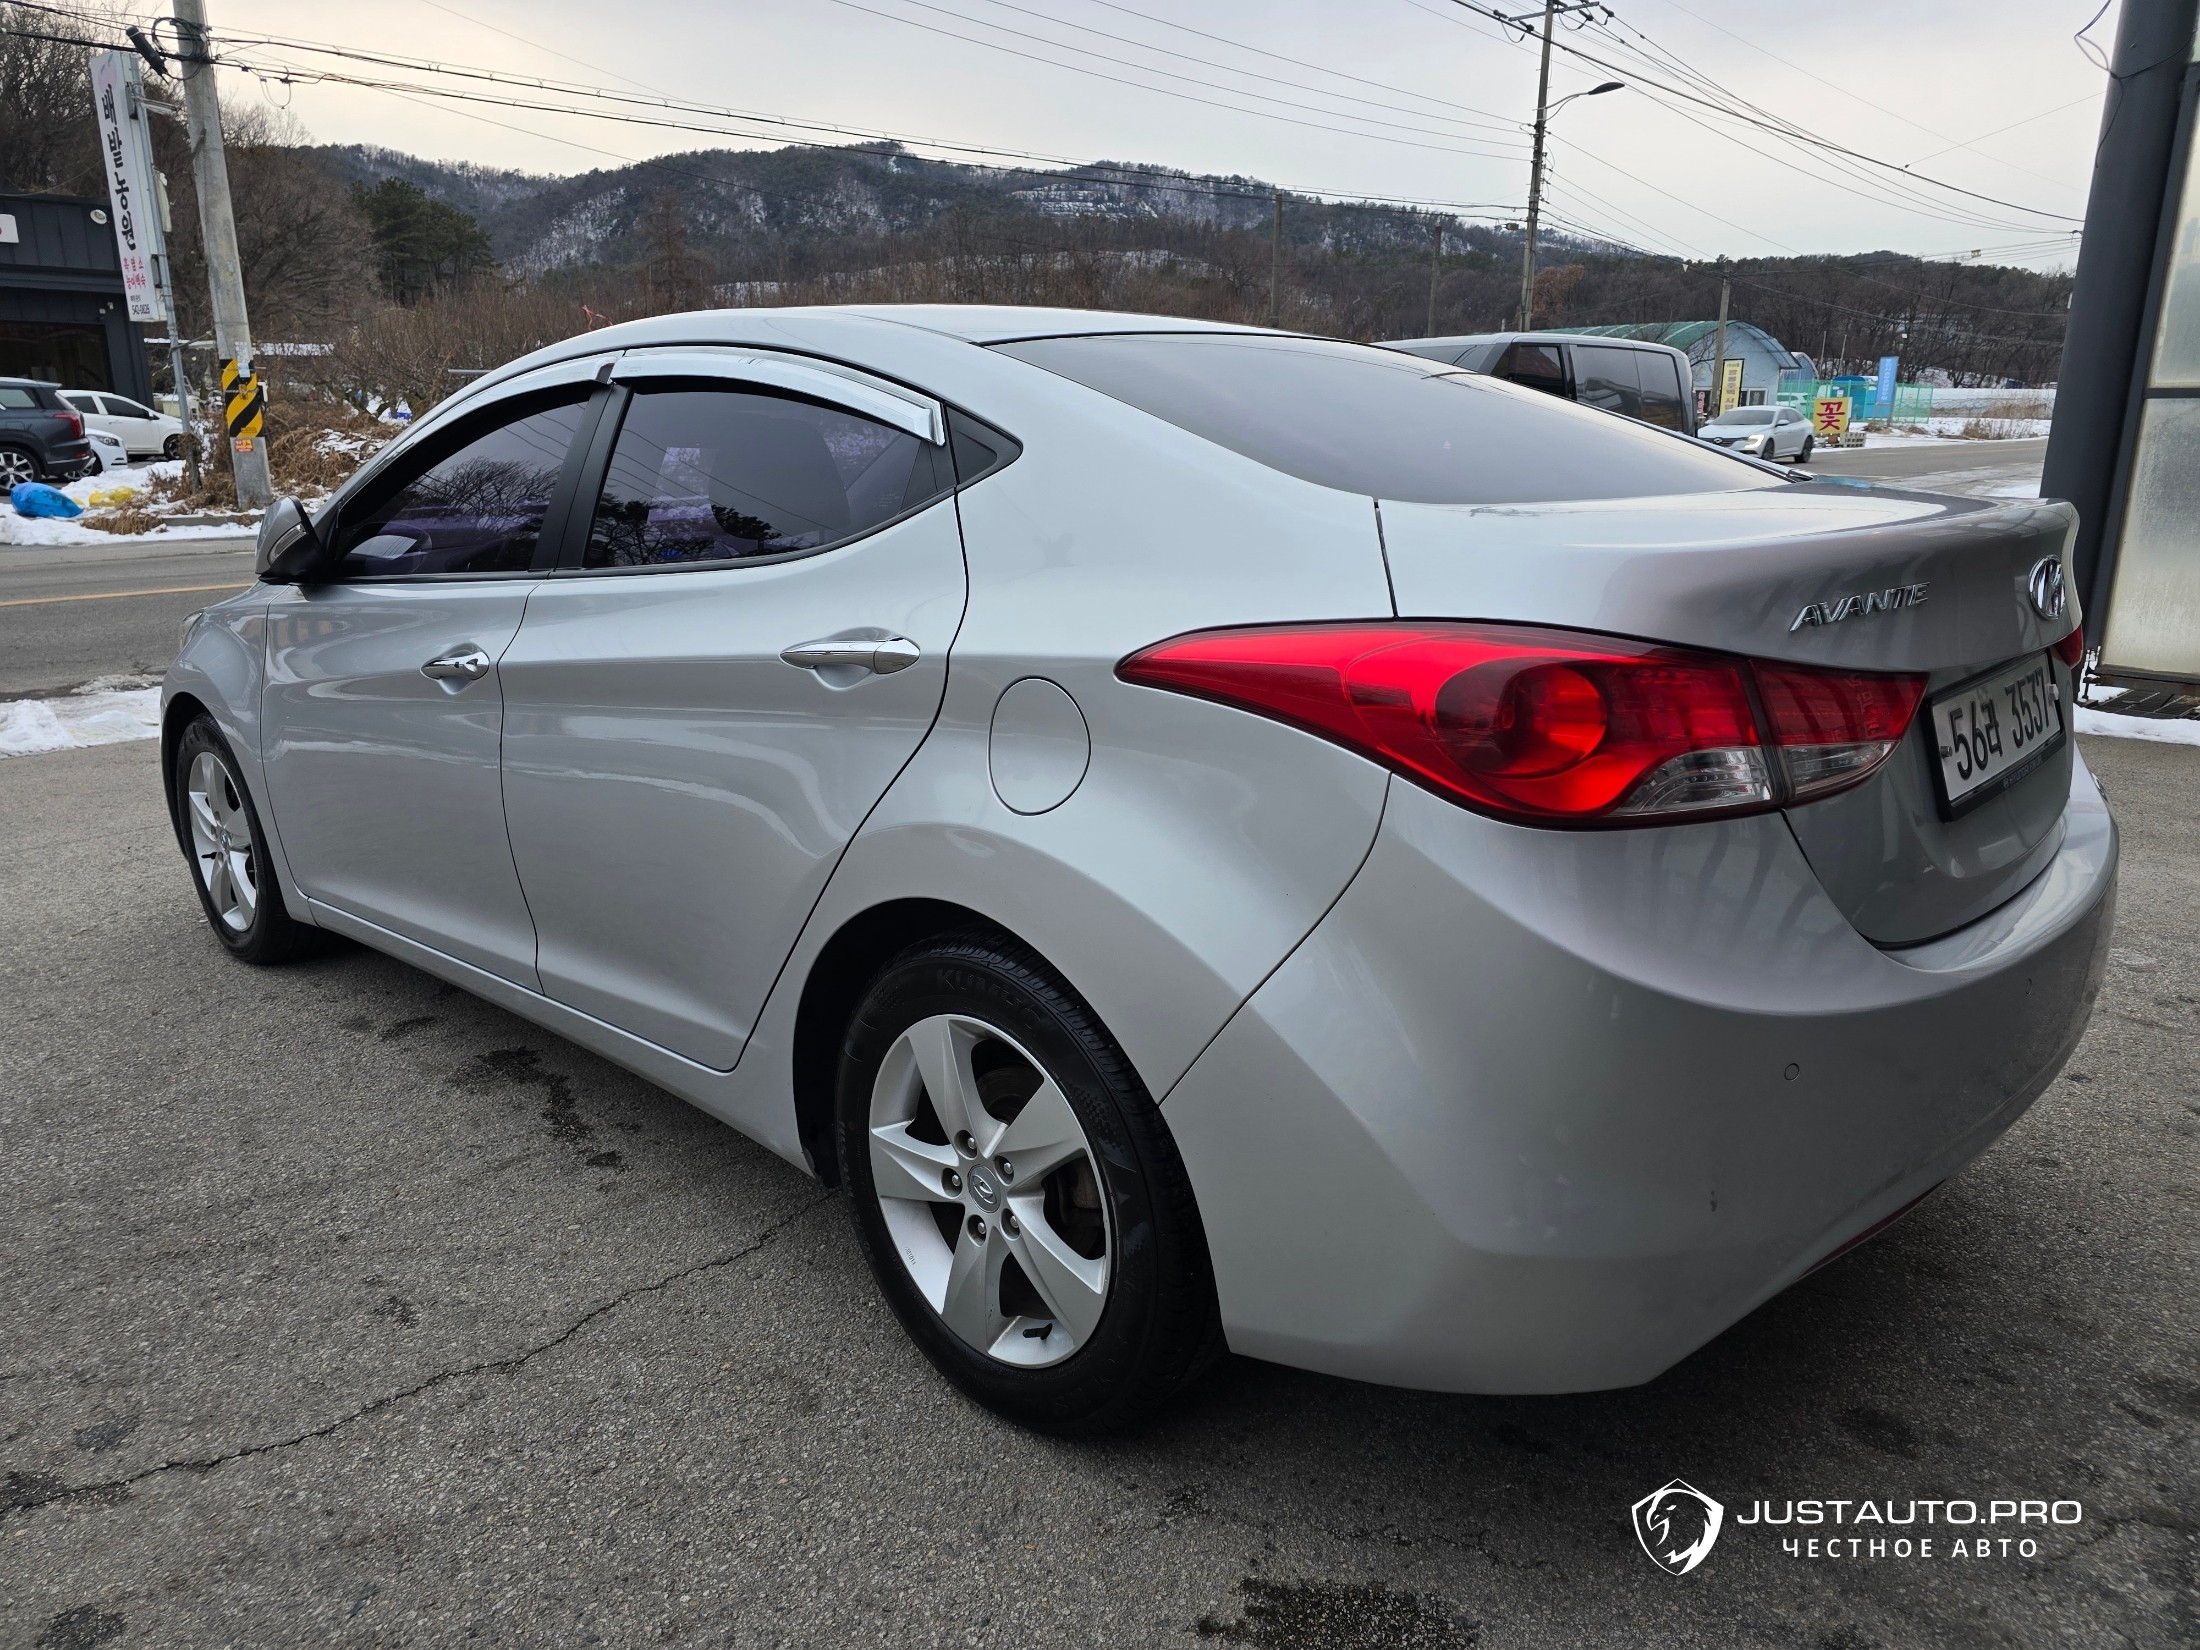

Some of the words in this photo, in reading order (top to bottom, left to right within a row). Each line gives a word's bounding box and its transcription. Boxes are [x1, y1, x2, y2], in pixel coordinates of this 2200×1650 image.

[101, 83, 137, 251] 배밭농원
[1816, 401, 1846, 432] 꽃
[1789, 581, 1930, 632] AVANTE
[1949, 698, 2003, 781] 56라
[2004, 665, 2050, 749] 3537
